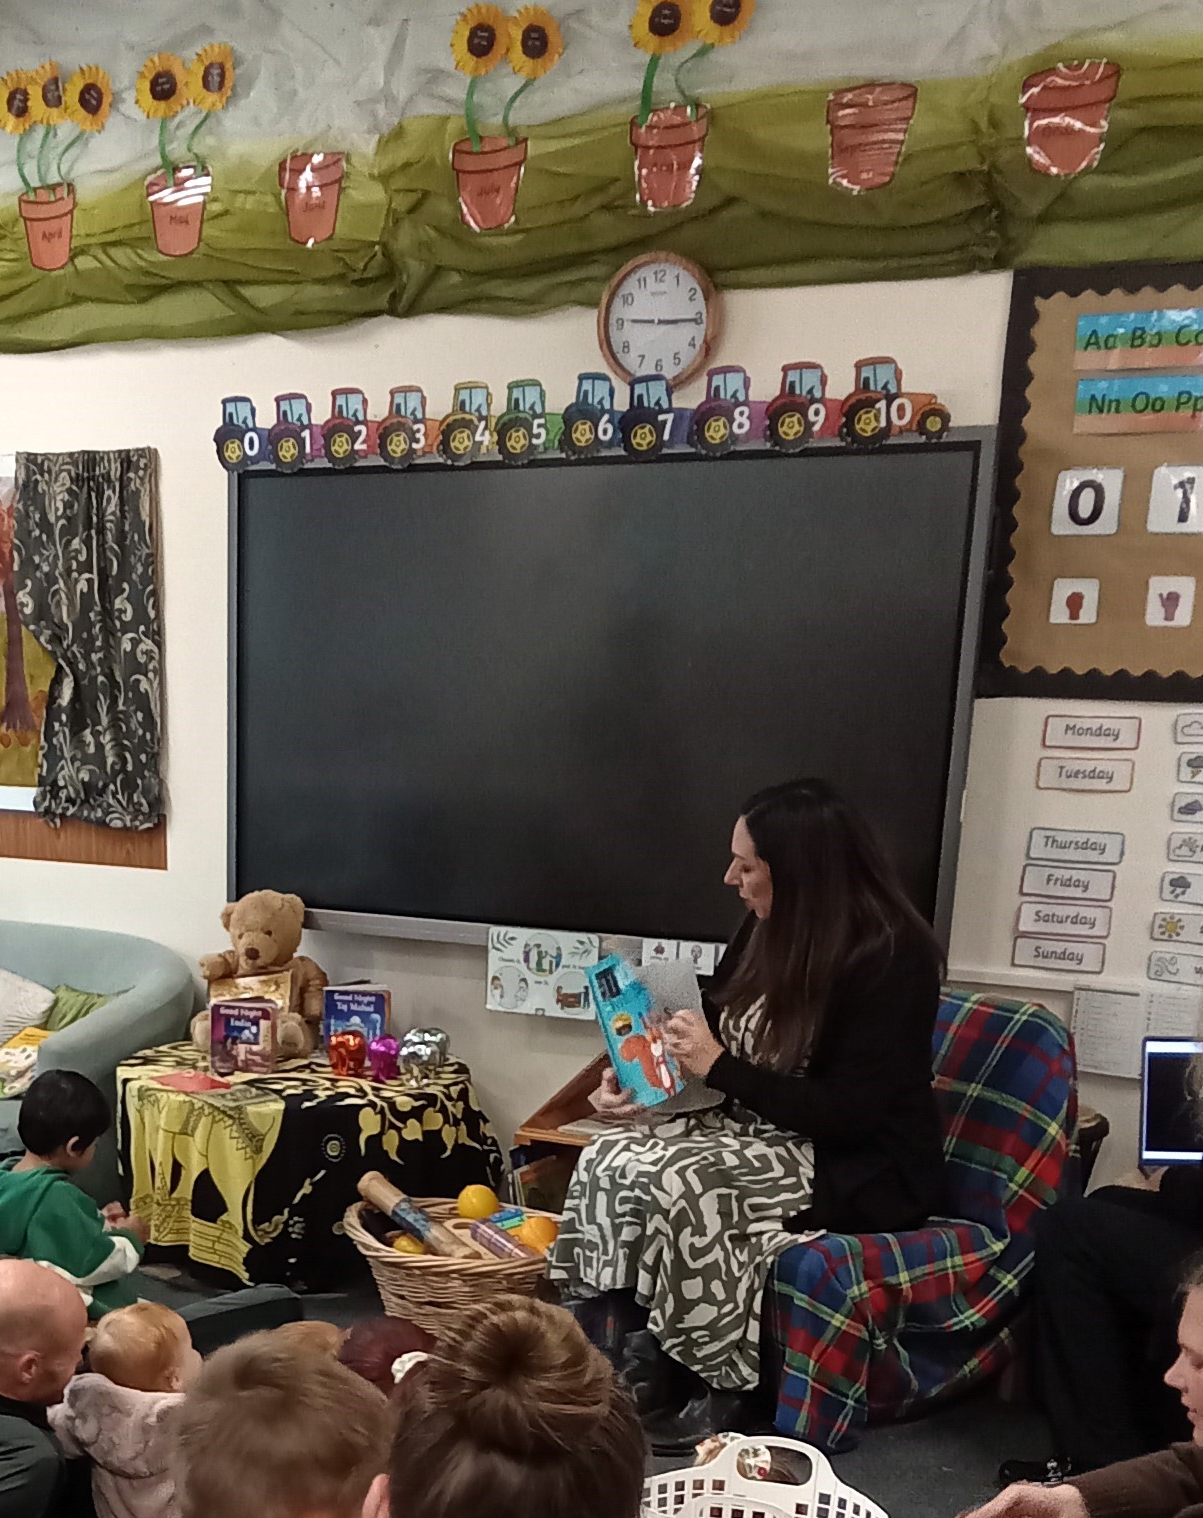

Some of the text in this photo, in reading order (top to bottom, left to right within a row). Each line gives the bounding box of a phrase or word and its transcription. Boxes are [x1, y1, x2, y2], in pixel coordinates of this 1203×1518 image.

[41, 229, 63, 243] April
[636, 276, 647, 289] 11
[653, 269, 667, 283] 12
[675, 273, 680, 288] 1
[621, 292, 634, 308] 10
[688, 287, 697, 302] 2
[616, 318, 625, 331] 9
[695, 311, 703, 325] 3
[622, 341, 630, 354] 8
[688, 336, 696, 349] 4
[1083, 329, 1117, 352] Aa
[637, 354, 646, 368] 7
[655, 358, 663, 372] 6
[673, 352, 681, 366] 5
[1088, 393, 1122, 414] Nn
[1131, 391, 1166, 414] Oo
[244, 398, 913, 456] 0 1 2 3 4 5 6 7 8 9 10
[1068, 476, 1197, 526] 0 1
[1064, 723, 1120, 741] Monday
[1057, 765, 1114, 784] Tuesday
[1043, 835, 1107, 854] Thursday
[1046, 873, 1090, 892] Friday
[1033, 910, 1097, 929] Saturday
[1033, 945, 1085, 963] Sunday
